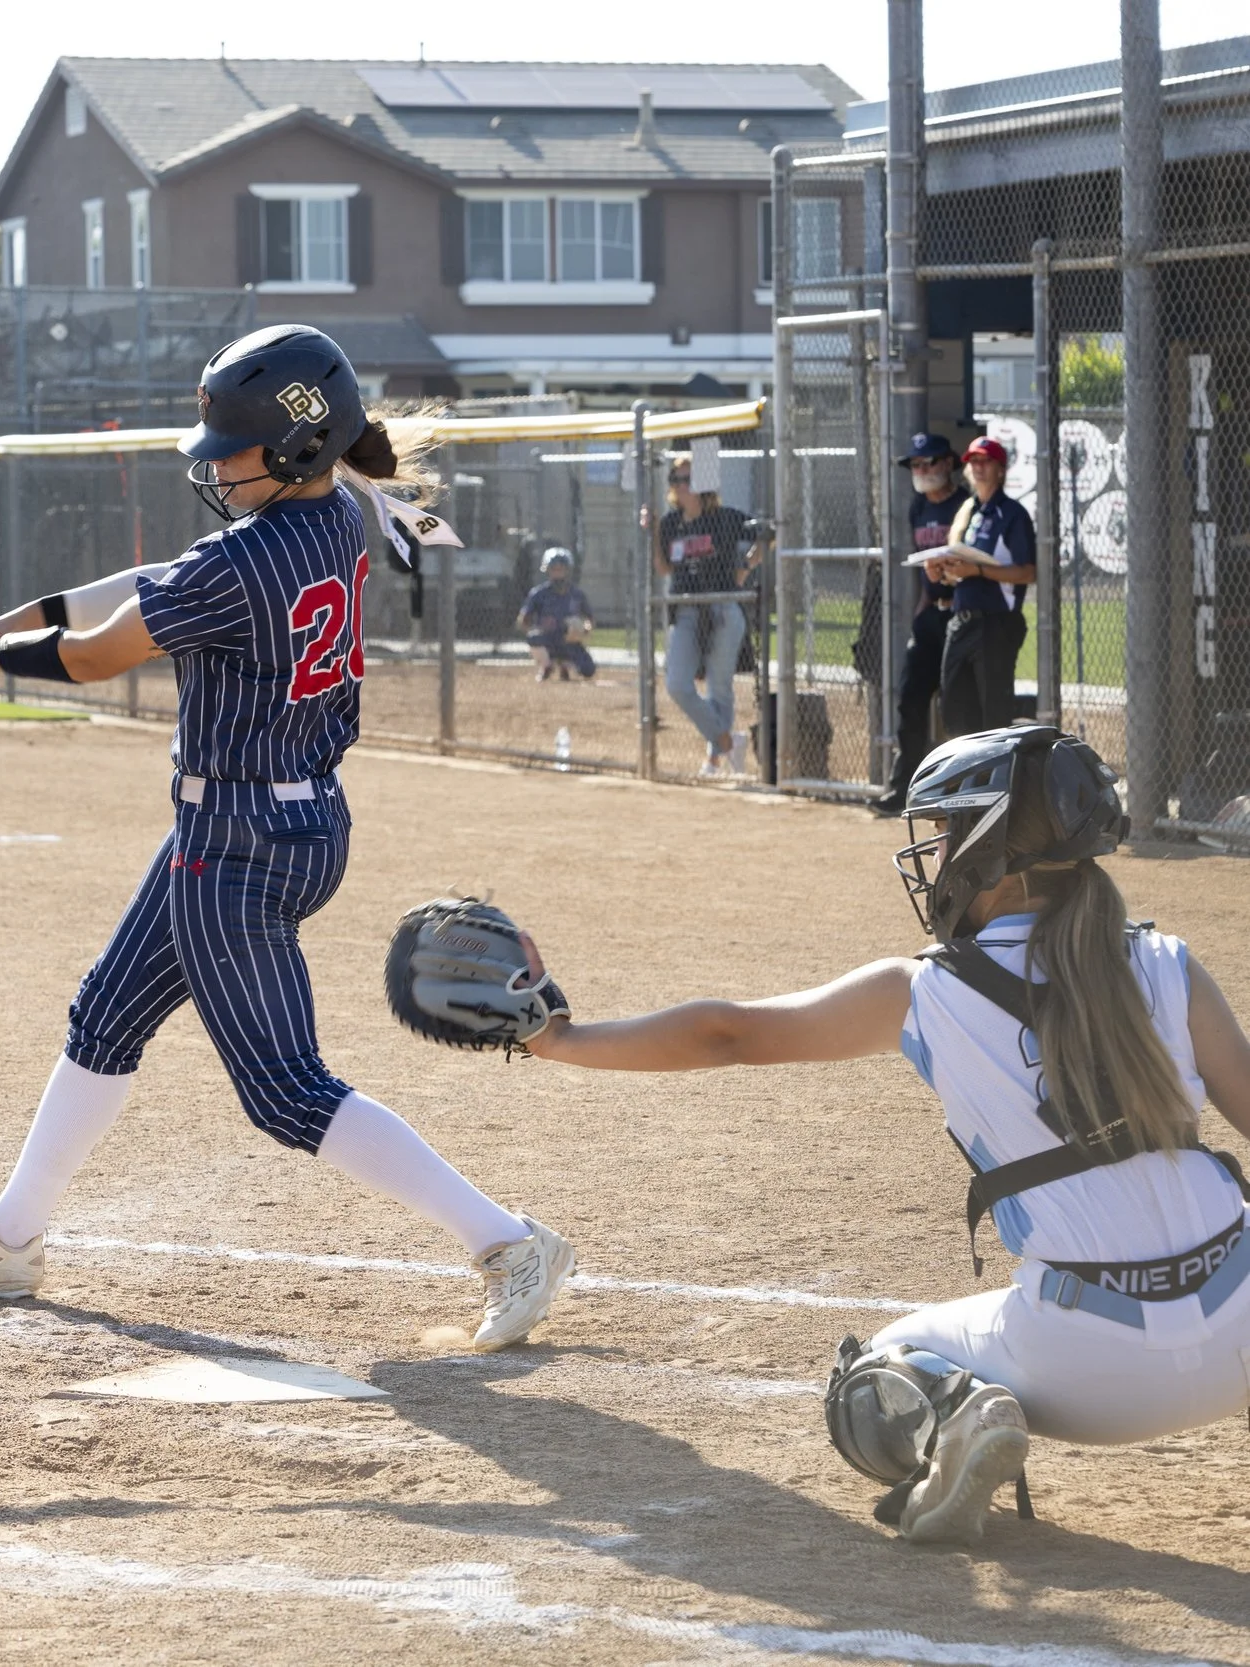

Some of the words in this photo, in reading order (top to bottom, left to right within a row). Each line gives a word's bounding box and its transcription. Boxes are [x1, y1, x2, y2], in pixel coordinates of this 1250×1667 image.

[276, 382, 330, 423] BU
[416, 516, 440, 535] 20
[1188, 353, 1216, 679] KING
[944, 799, 977, 807] EASTON
